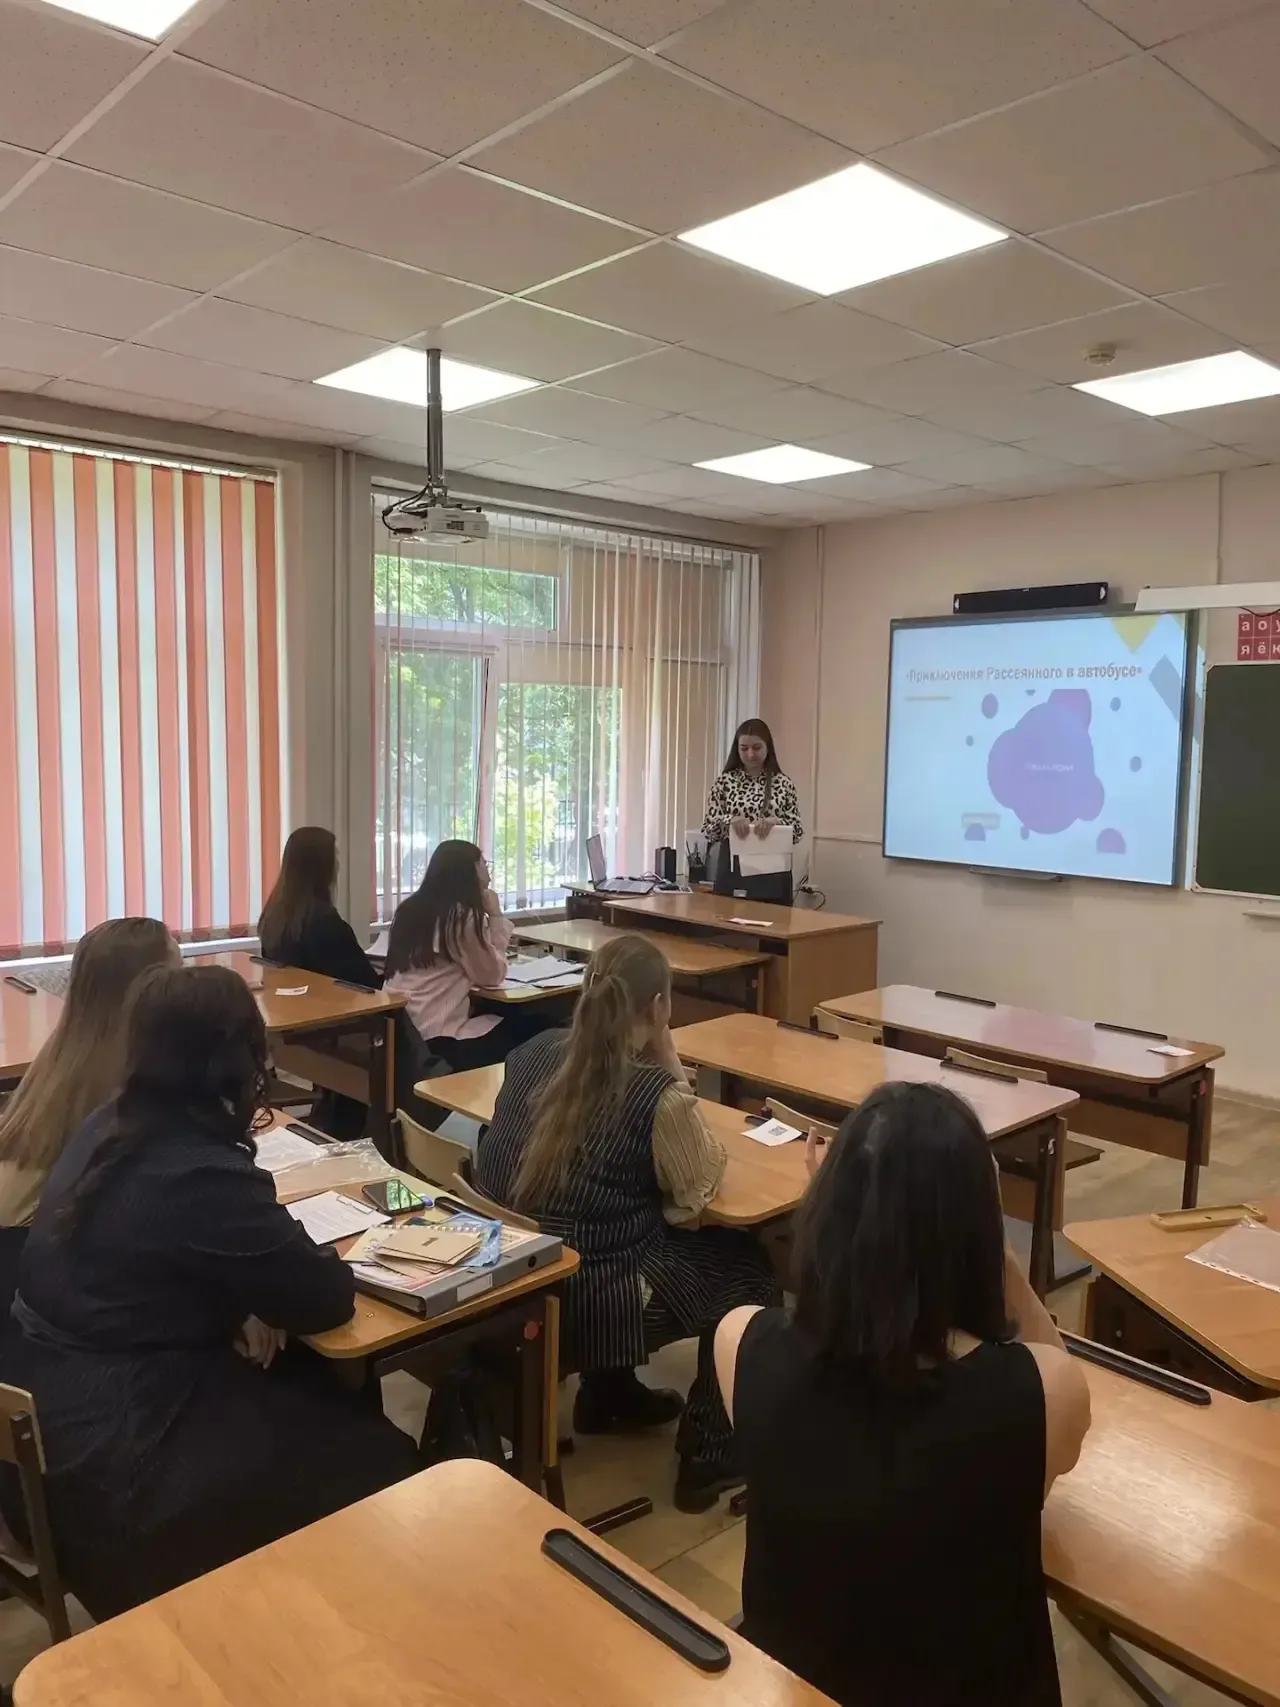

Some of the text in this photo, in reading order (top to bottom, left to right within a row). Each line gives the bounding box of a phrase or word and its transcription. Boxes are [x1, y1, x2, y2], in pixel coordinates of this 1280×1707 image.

[1242, 621, 1250, 631] а
[1258, 620, 1267, 631] о
[1241, 645, 1250, 655] я
[1258, 641, 1266, 654] ё
[987, 666, 1062, 681] Рассеянного
[1066, 667, 1074, 677] в
